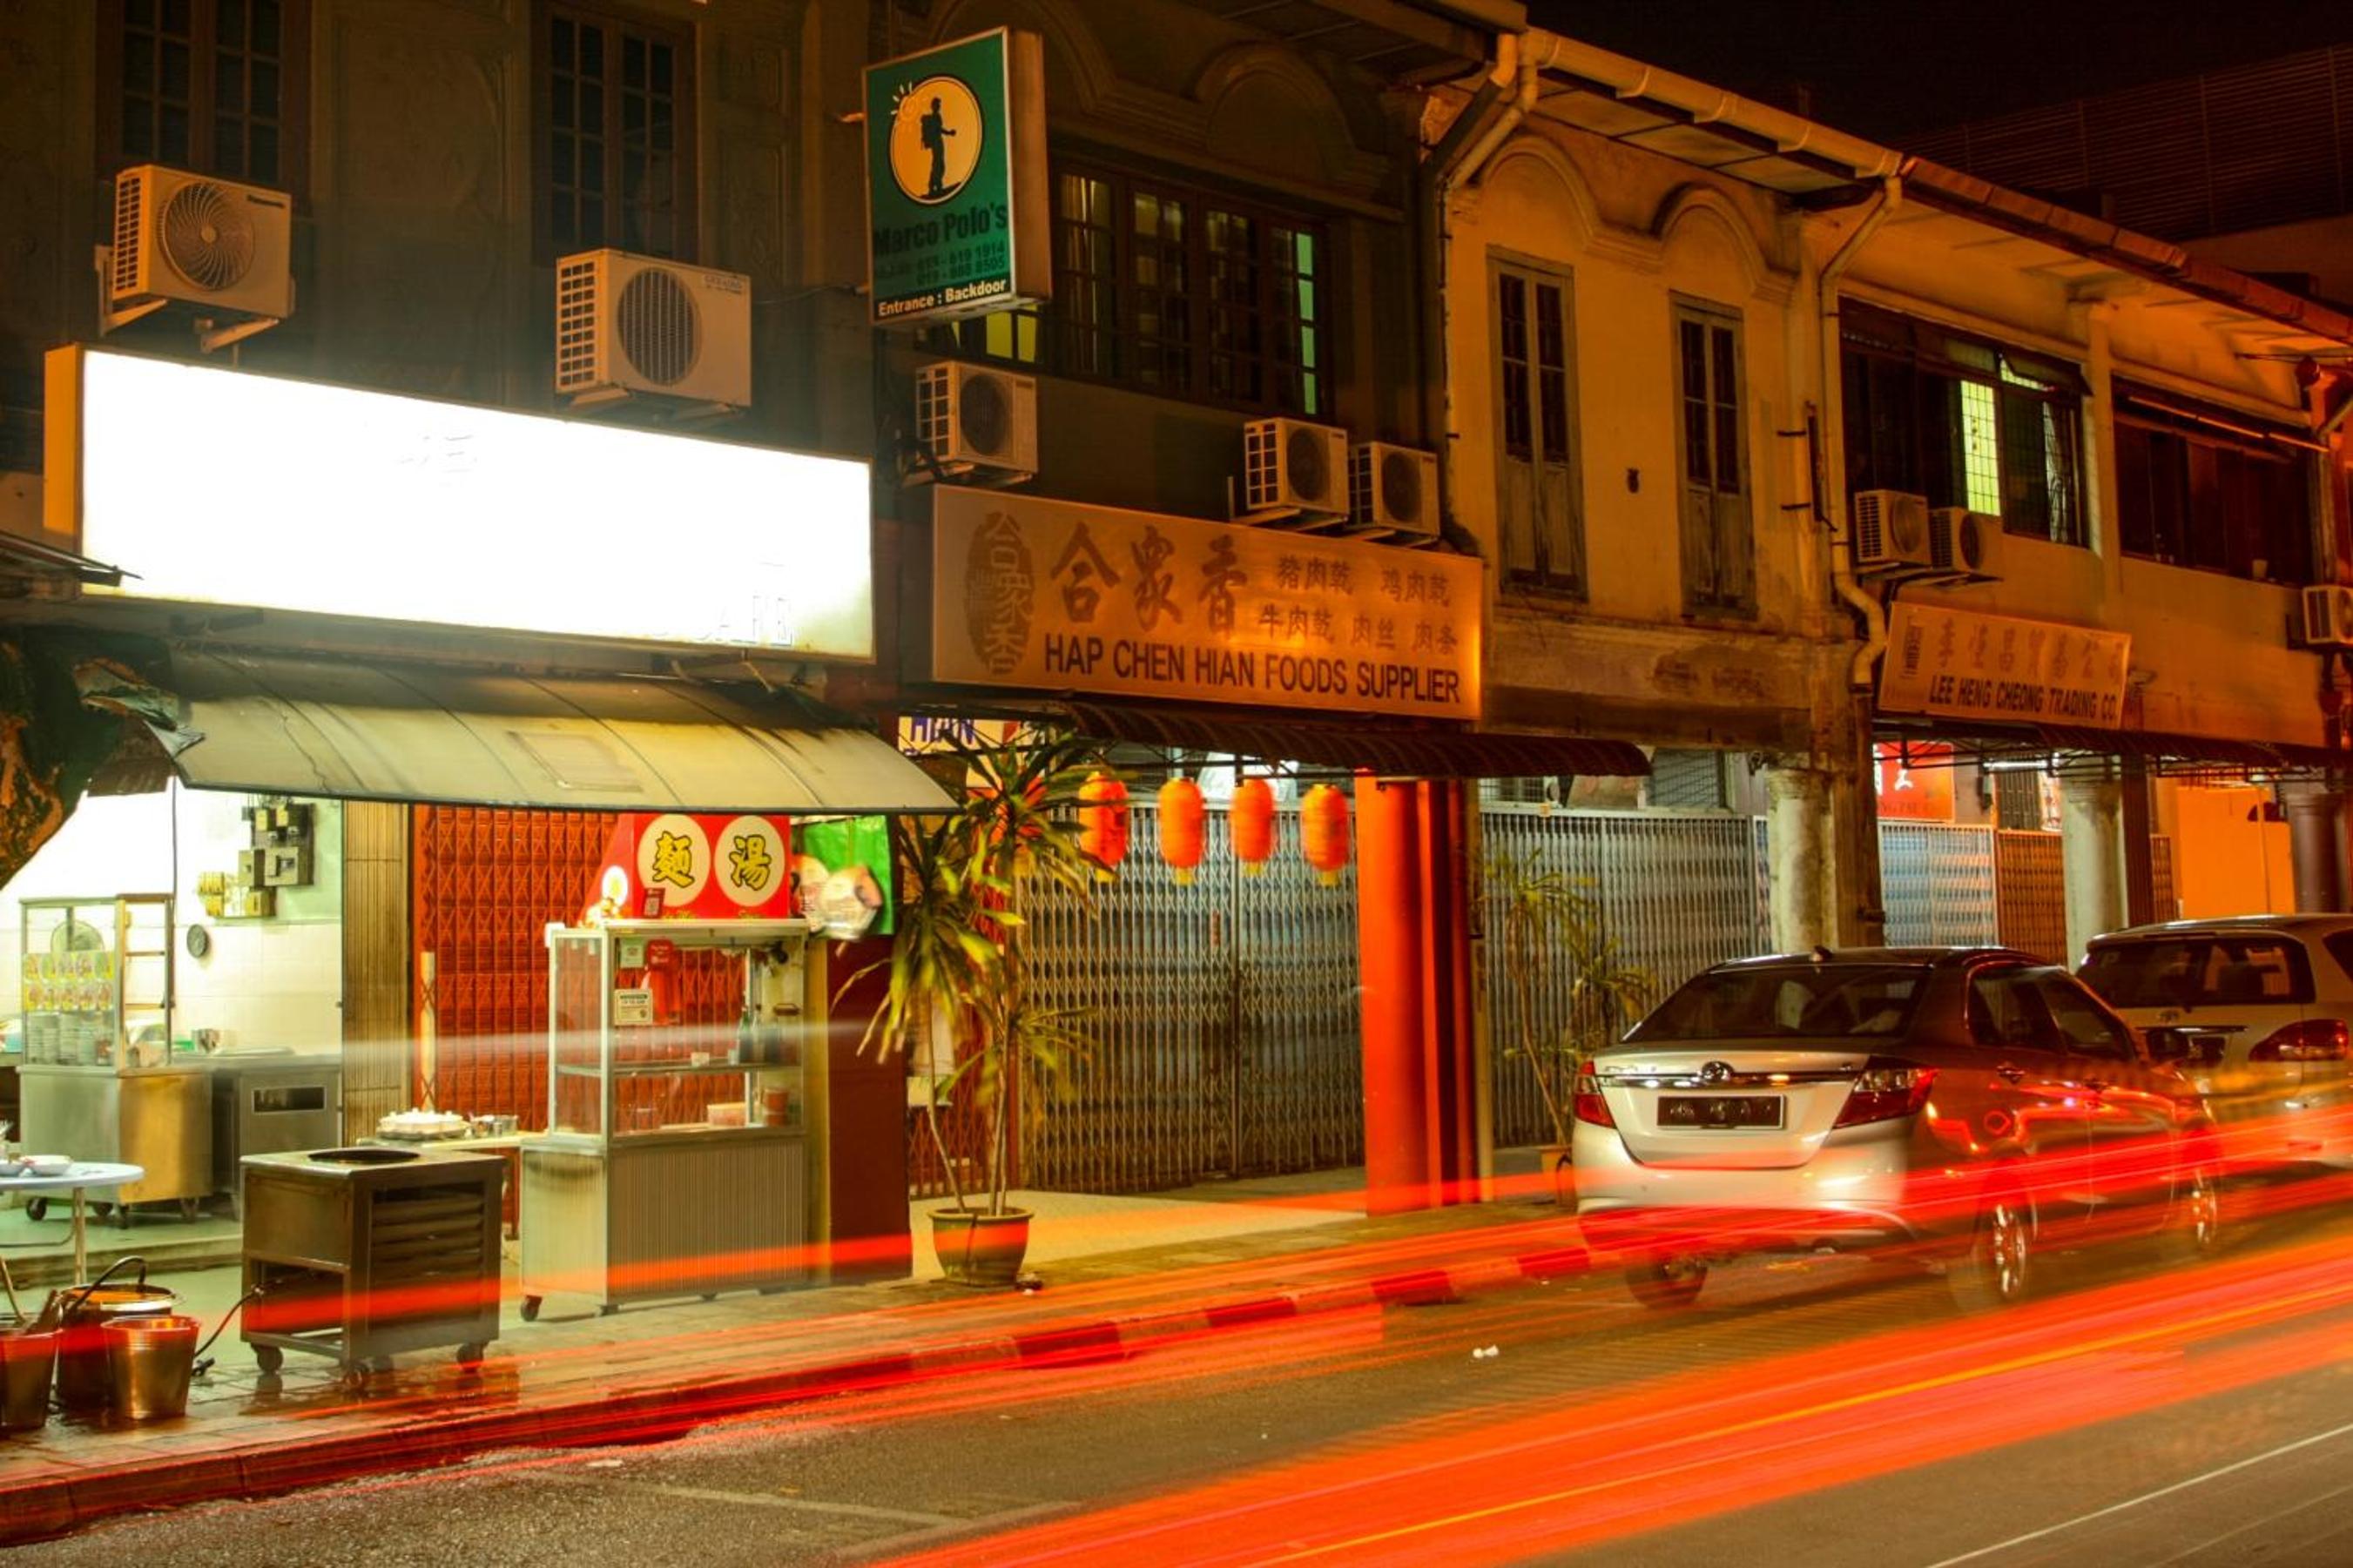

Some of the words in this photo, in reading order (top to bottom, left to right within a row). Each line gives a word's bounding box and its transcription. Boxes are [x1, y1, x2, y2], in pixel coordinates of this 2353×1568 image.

[874, 220, 939, 256] Marco
[943, 202, 1008, 242] Polo's
[878, 294, 935, 316] Entrance
[944, 279, 1007, 303] Backdoor
[1045, 633, 1104, 675] HAP
[1113, 639, 1185, 683] CHEN
[1195, 646, 1255, 688] HIAN
[1265, 652, 1347, 695] FOODS
[1357, 660, 1461, 704] SUPPLIER
[1929, 674, 1955, 704] LEE
[1958, 676, 1992, 709] HENG
[1996, 681, 2044, 713] CHEONG
[2047, 686, 2097, 719] TRADING
[652, 830, 696, 889] 麵
[729, 834, 772, 891] 湯
